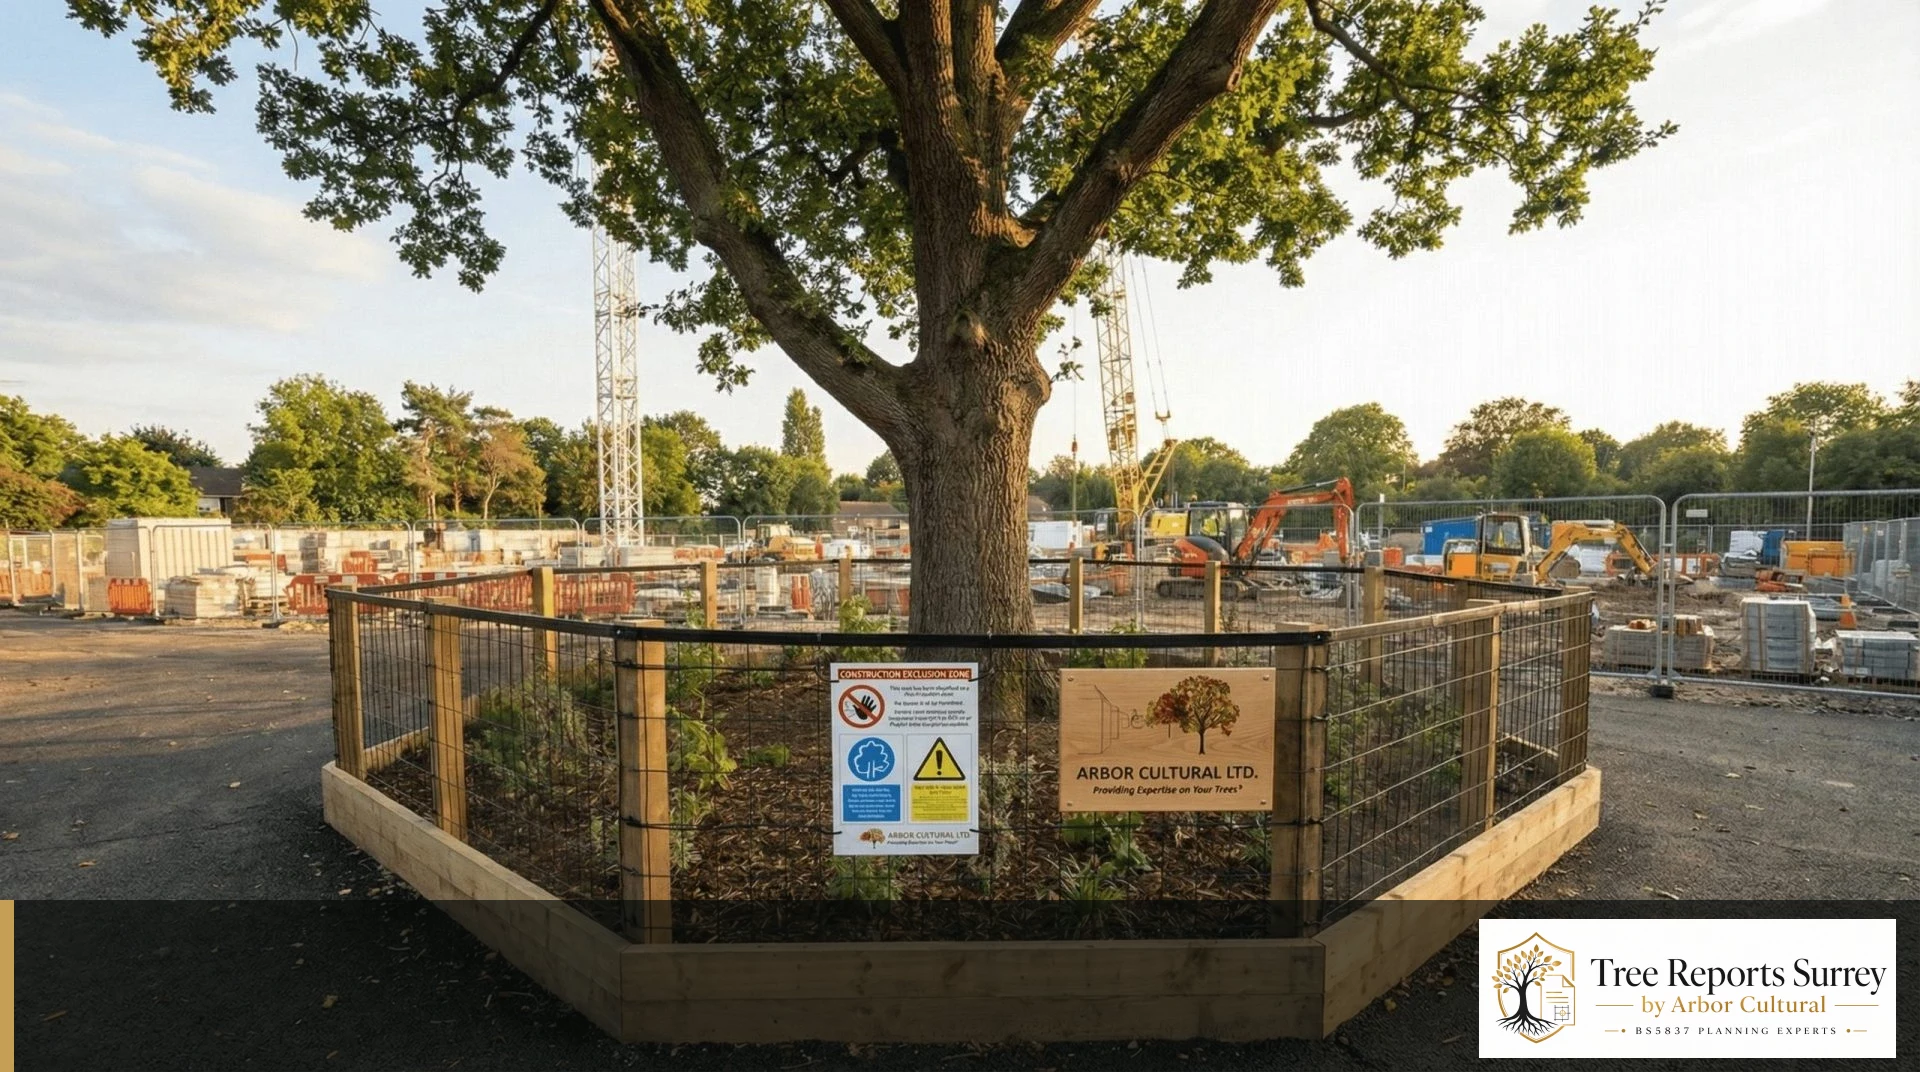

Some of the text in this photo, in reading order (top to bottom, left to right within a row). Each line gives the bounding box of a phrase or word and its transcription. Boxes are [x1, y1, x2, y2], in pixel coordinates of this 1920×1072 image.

[839, 670, 901, 679] CONSTRUCTION
[902, 670, 946, 679] EXCLUSION
[1076, 766, 1258, 780] ARBOR CULTURAL LTD.
[1093, 785, 1135, 796] Providing
[1137, 785, 1177, 796] Expertise
[1193, 785, 1213, 794] Your
[888, 831, 915, 839] ARBOR
[916, 831, 955, 839] CULTURAL
